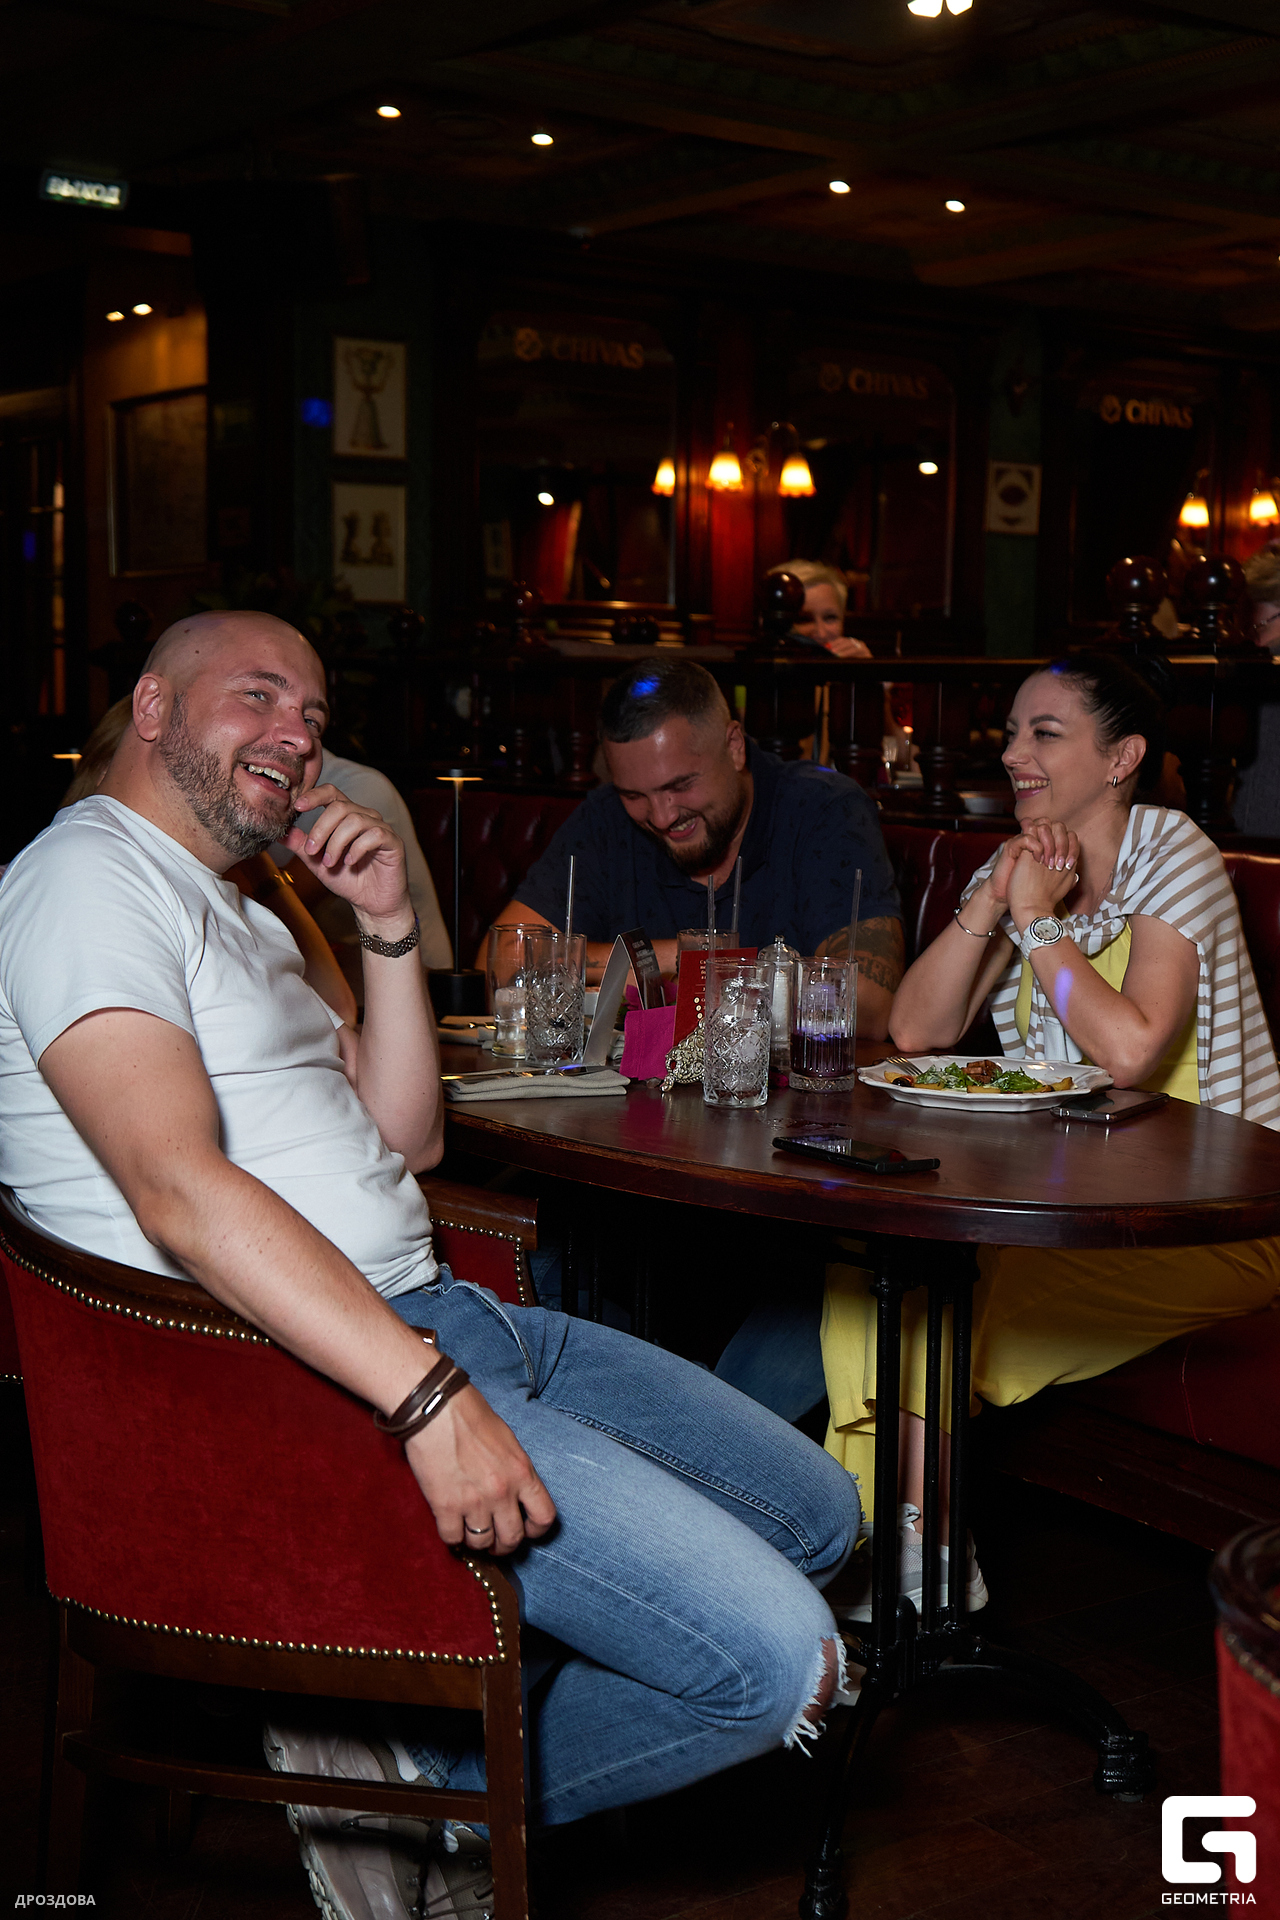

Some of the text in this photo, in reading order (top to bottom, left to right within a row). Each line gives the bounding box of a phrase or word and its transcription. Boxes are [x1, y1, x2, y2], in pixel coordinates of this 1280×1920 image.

[45, 175, 121, 205] ВЫХОД
[551, 333, 644, 370] CHIVAS
[848, 366, 929, 400] CHIVAS
[1124, 398, 1194, 430] CHIVAS
